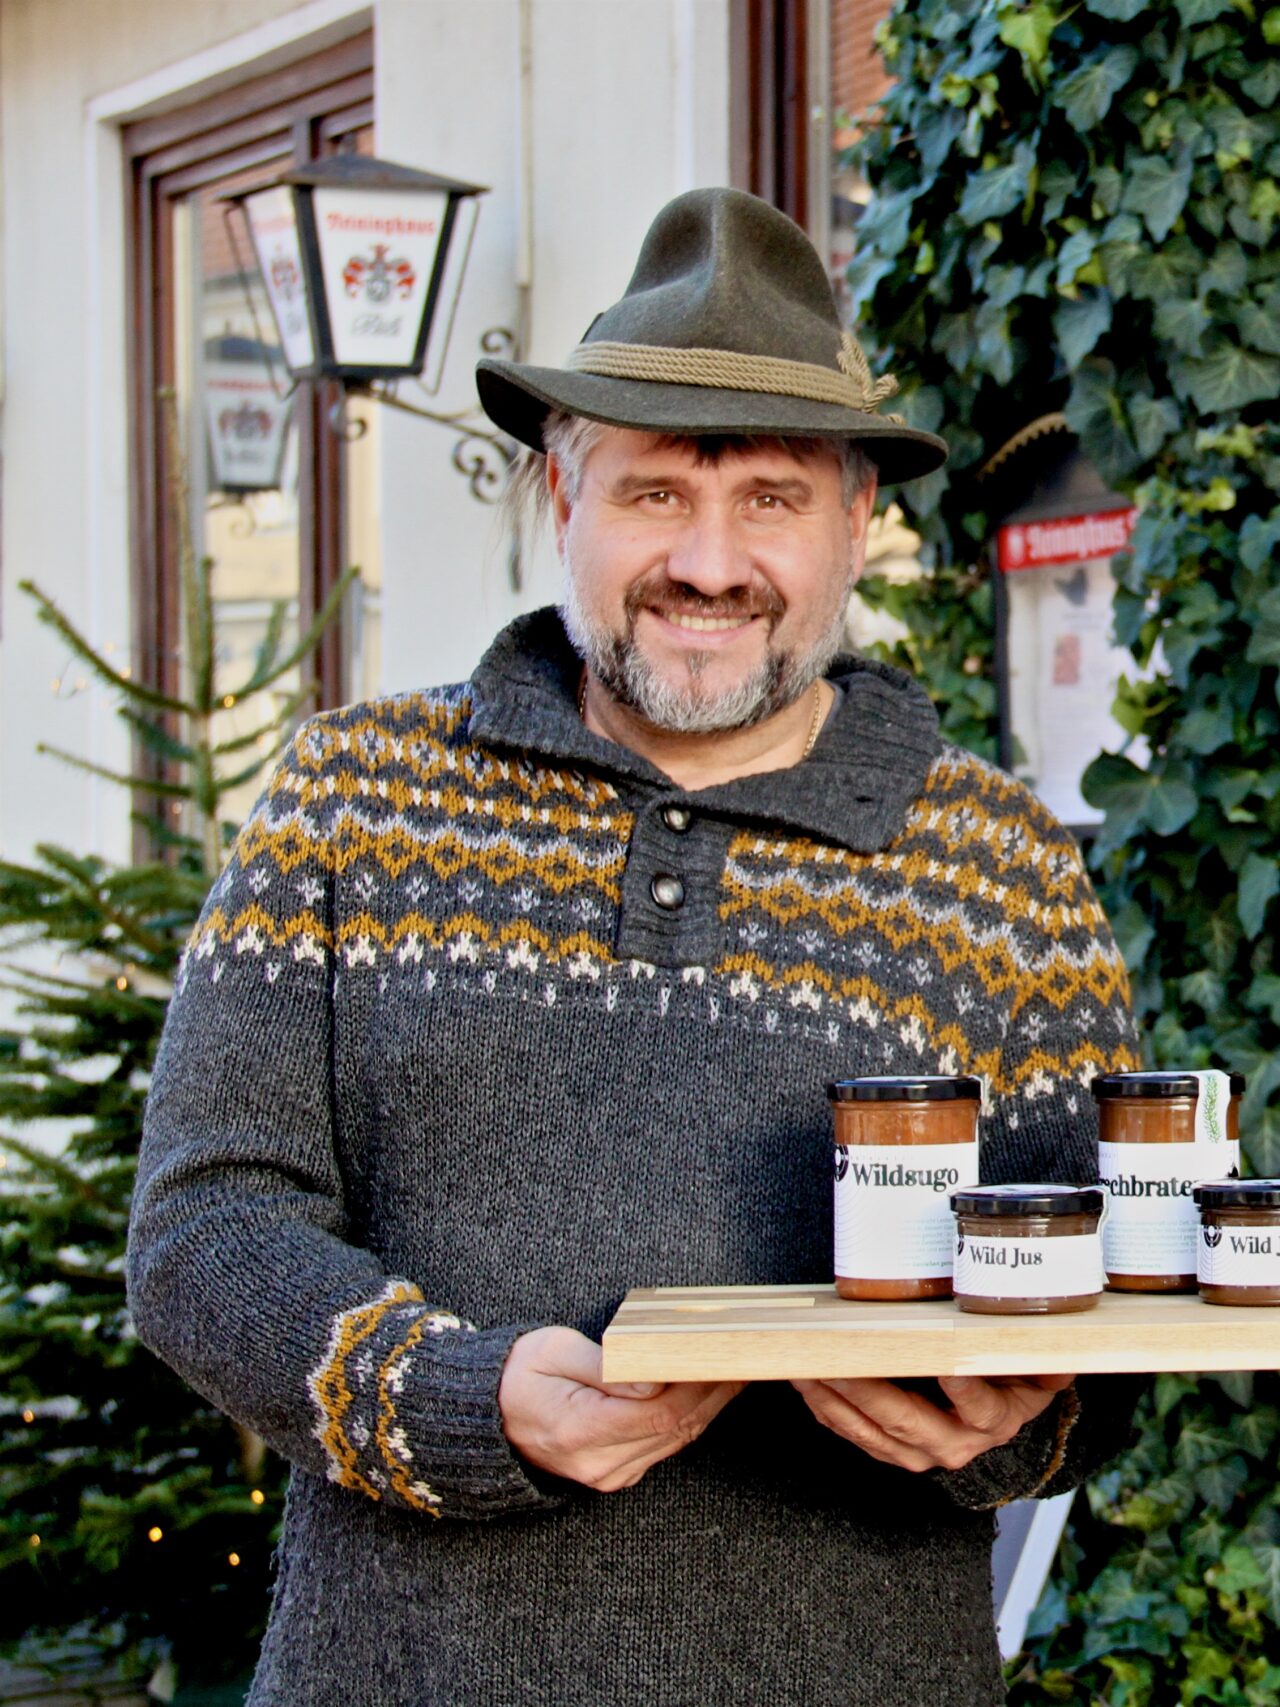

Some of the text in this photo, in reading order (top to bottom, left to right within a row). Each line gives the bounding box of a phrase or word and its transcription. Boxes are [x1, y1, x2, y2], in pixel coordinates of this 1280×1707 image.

[852, 1163, 959, 1192] Wildsugo
[970, 1245, 1043, 1268] Wild Jus
[1230, 1236, 1272, 1255] Wild
